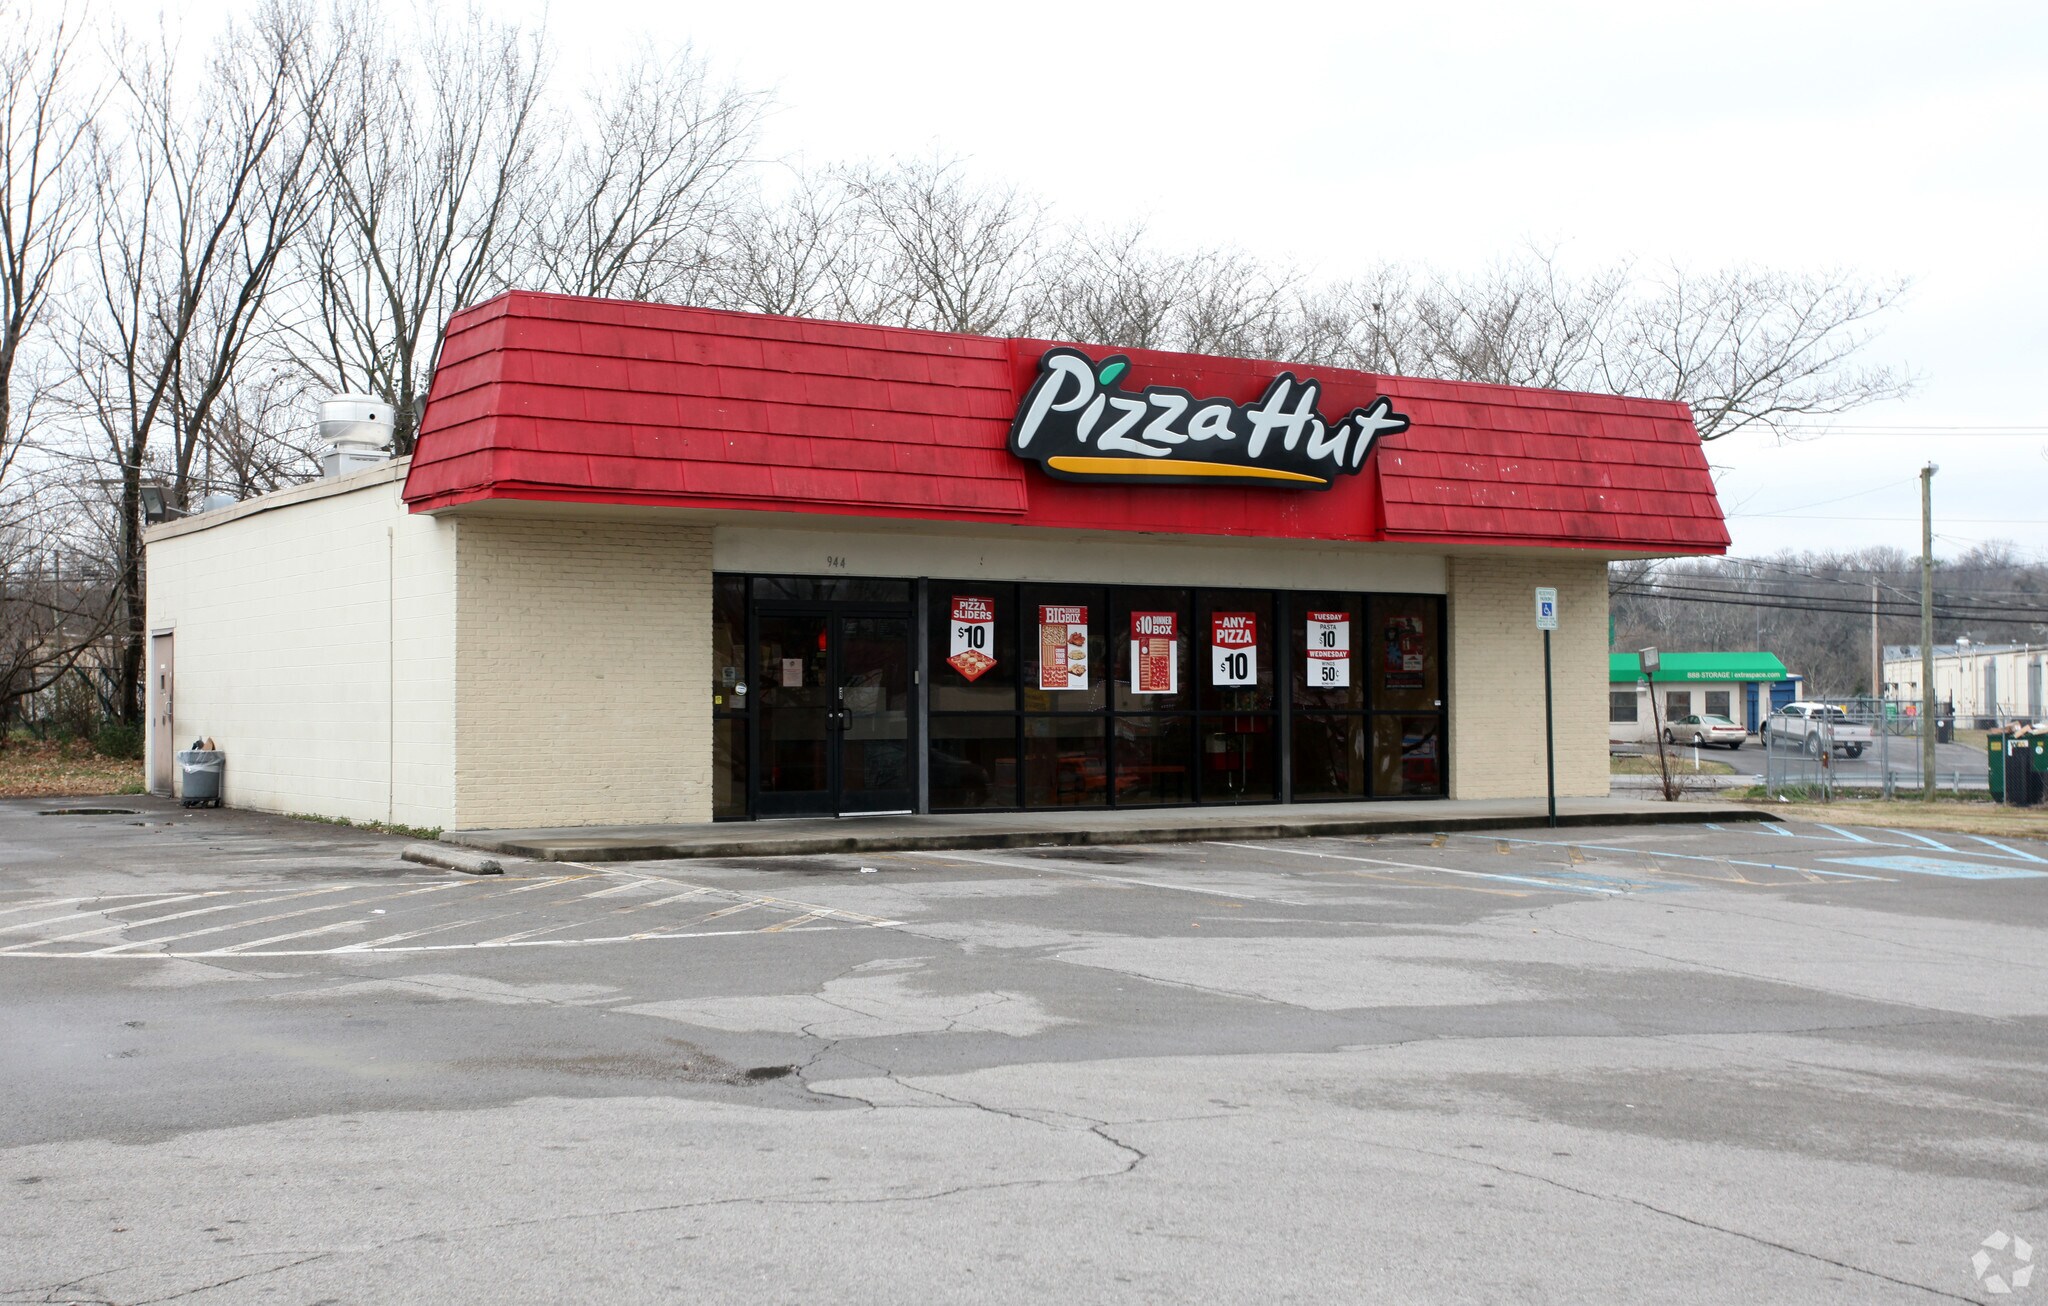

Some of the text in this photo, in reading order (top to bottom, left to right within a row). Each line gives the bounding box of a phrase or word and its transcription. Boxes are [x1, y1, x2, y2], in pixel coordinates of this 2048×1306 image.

[1017, 355, 1405, 469] Pizza Hut
[827, 555, 846, 569] 944
[960, 601, 987, 611] PIZZA
[953, 610, 992, 620] SLIDERS
[1045, 607, 1066, 623] BIG
[1065, 613, 1080, 623] BOX
[1136, 615, 1172, 634] $10 DINNER
[1152, 625, 1172, 635] BOX
[958, 625, 985, 649] $10
[1216, 629, 1252, 644] PIZZA
[1319, 630, 1336, 648] $10
[1309, 650, 1347, 658] WEDNESDAY
[1220, 652, 1248, 680] $10
[1734, 671, 1780, 679] extraspace.com
